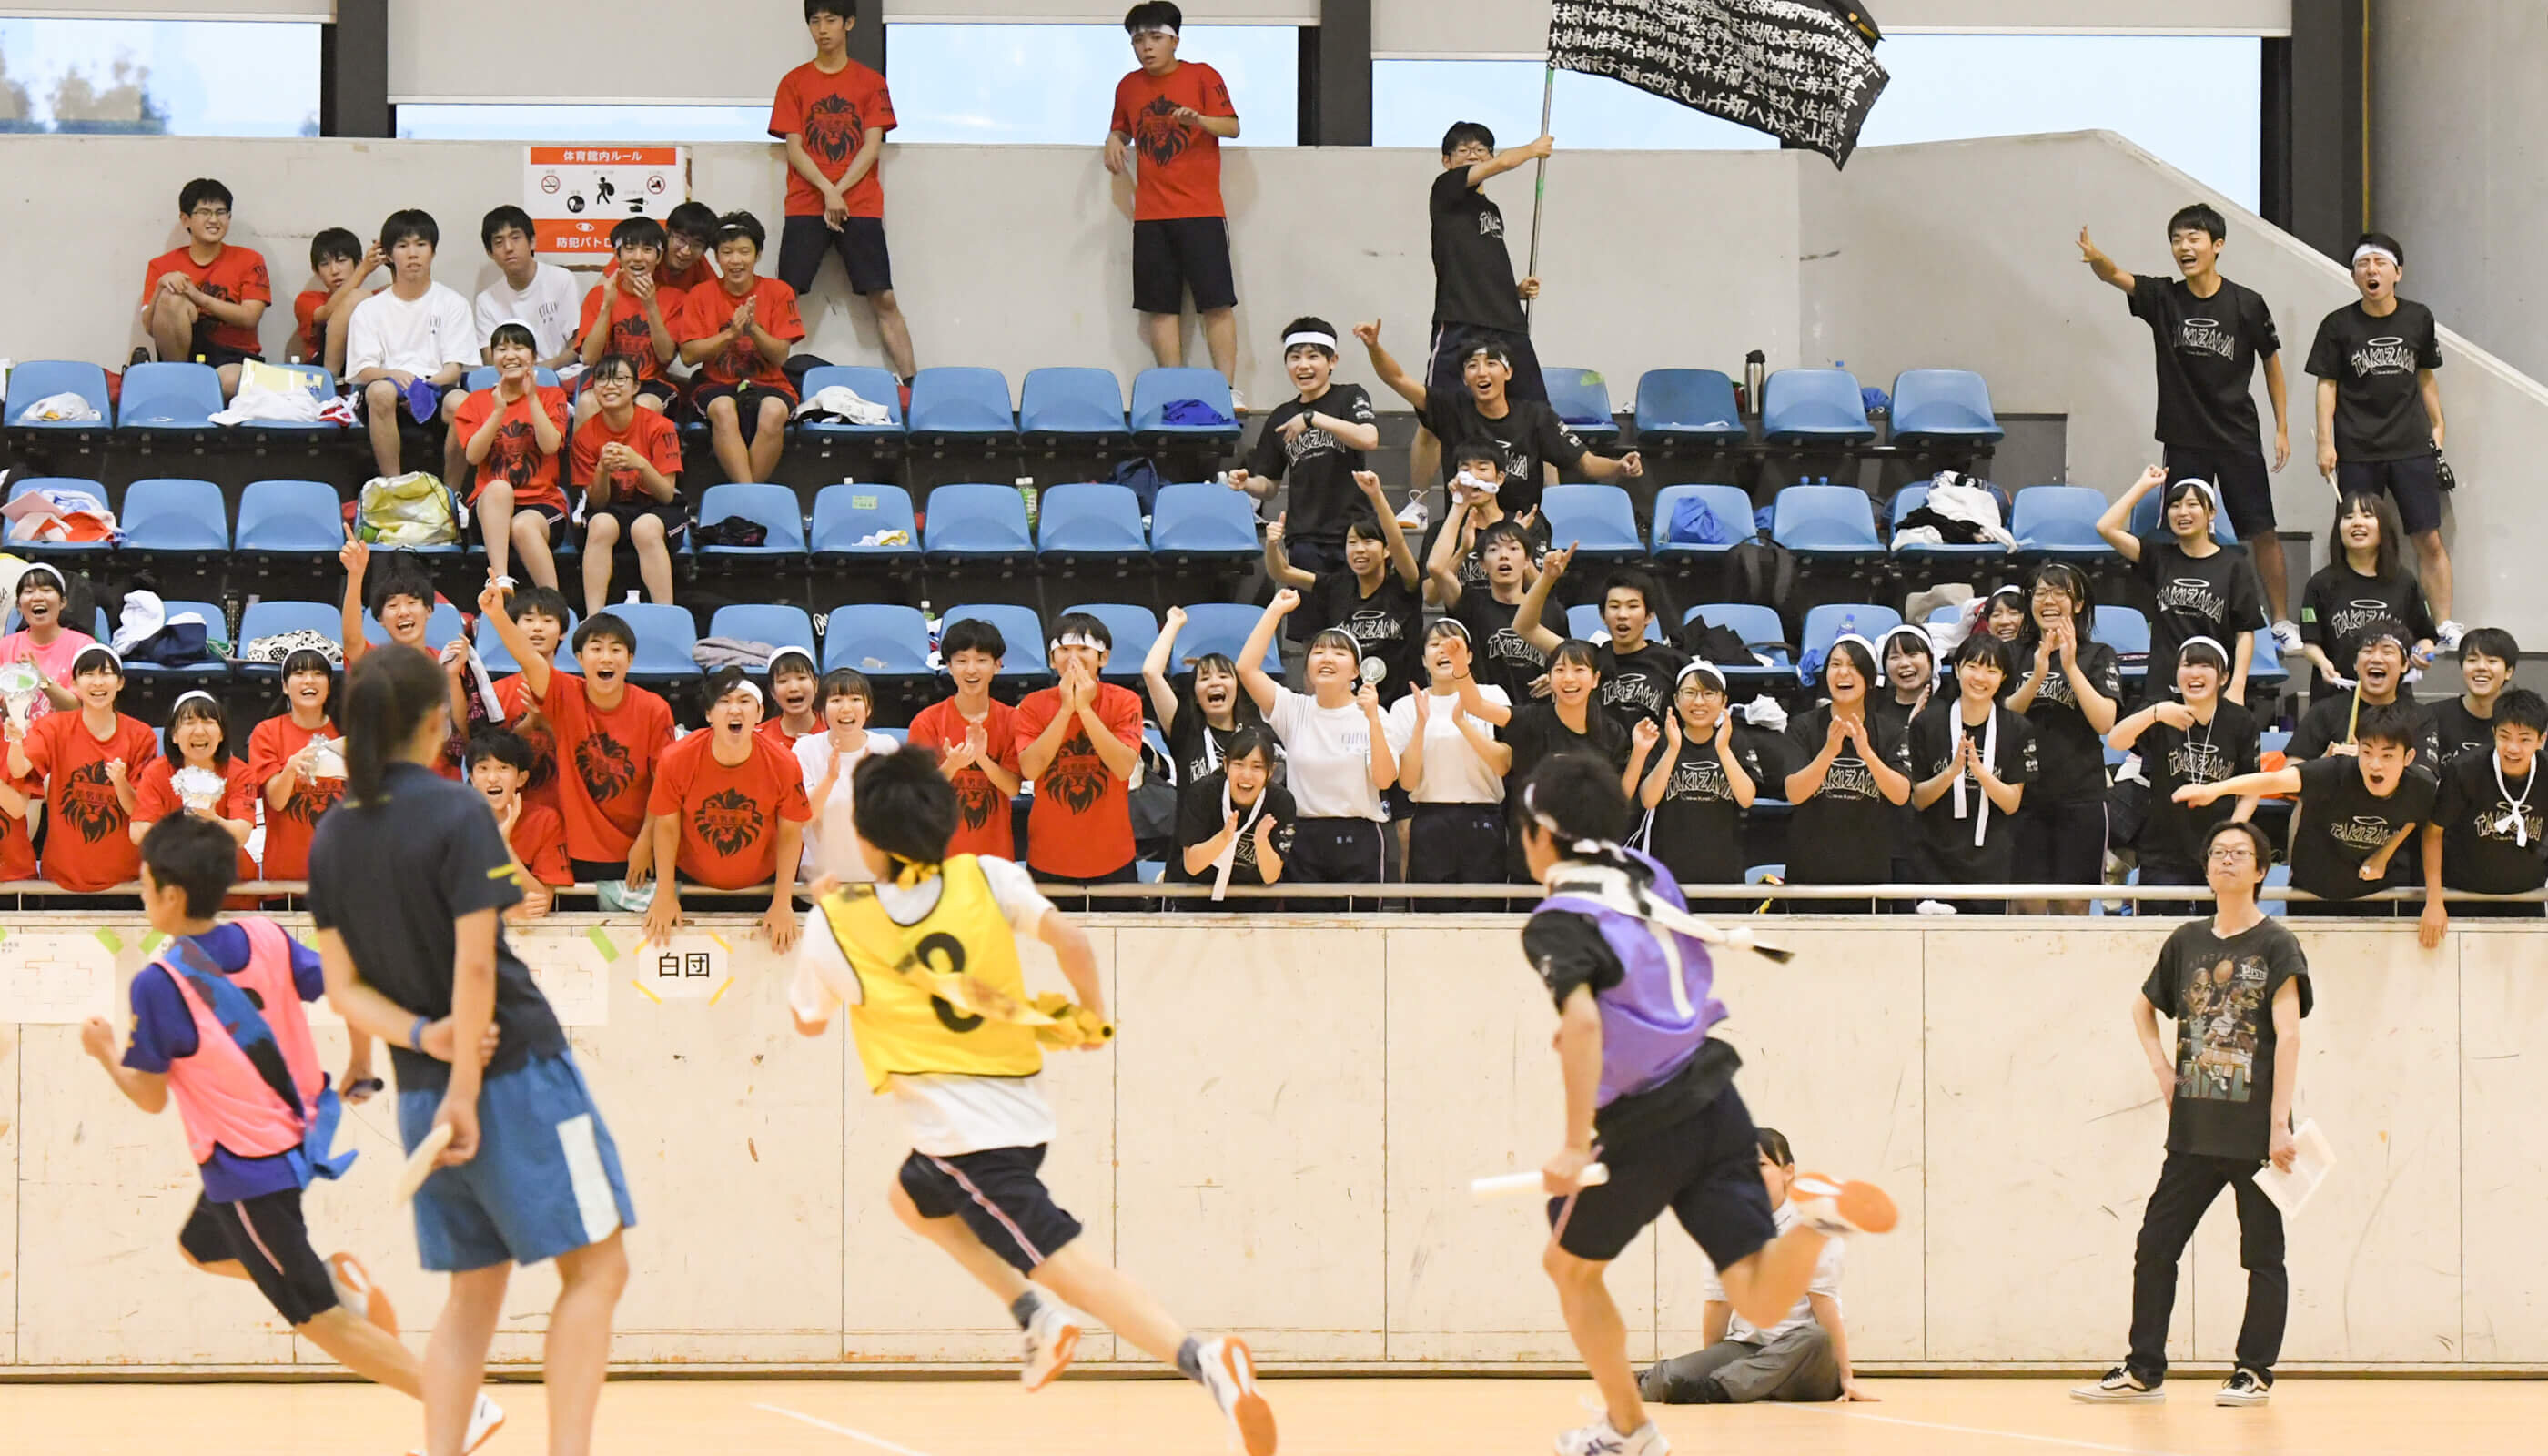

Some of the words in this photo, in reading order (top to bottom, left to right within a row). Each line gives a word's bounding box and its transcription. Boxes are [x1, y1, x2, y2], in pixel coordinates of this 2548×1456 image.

[563, 150, 642, 162] 体育館内ルール
[659, 952, 710, 978] 白団
